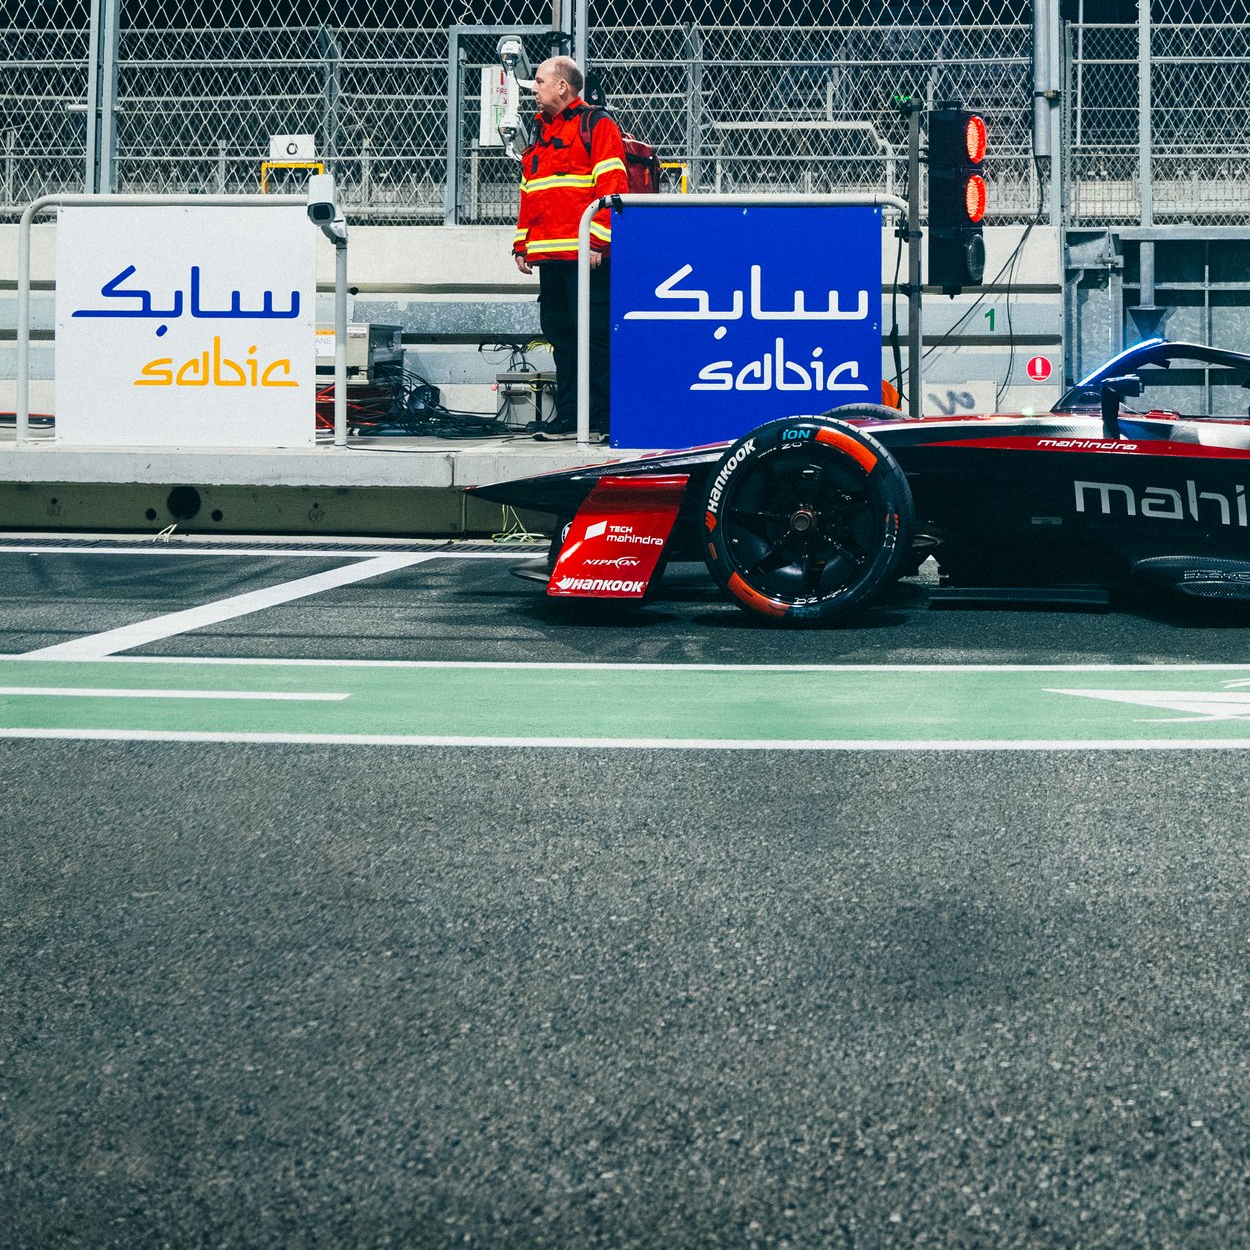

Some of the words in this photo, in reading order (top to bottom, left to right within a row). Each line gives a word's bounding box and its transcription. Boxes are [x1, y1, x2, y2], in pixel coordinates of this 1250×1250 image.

[984, 308, 996, 332] 1
[133, 336, 300, 387] sabic
[690, 337, 869, 391] sabic
[1037, 439, 1138, 451] mahindra
[609, 525, 633, 533] TECH
[606, 534, 664, 546] mahindra
